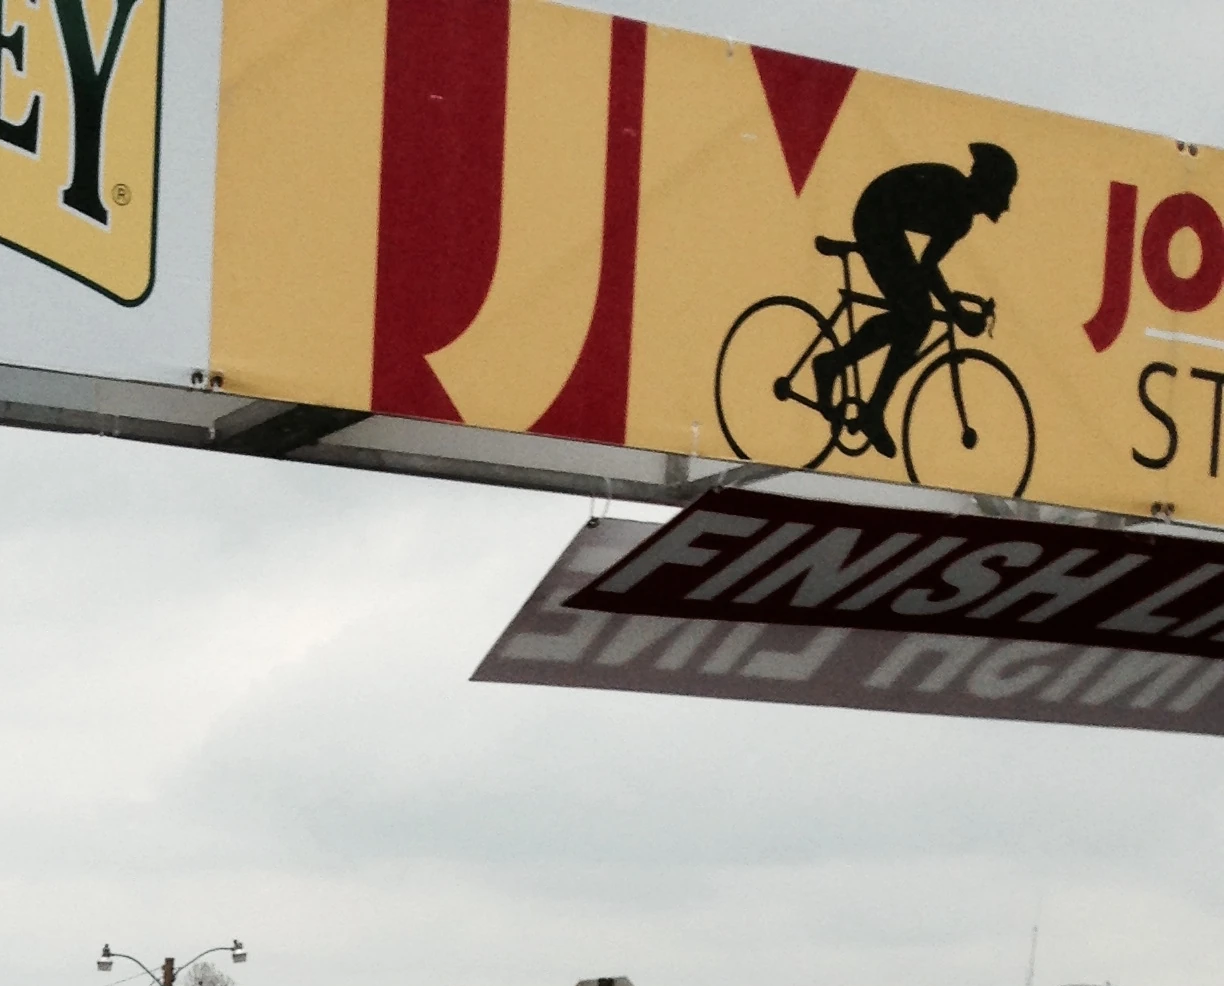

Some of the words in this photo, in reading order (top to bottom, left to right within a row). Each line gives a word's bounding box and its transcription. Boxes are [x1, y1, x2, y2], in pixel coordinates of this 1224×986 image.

[1082, 180, 1224, 353] JO
[1132, 361, 1224, 478] ST
[596, 510, 1153, 624] FINISH
[1096, 562, 1224, 641] LI
